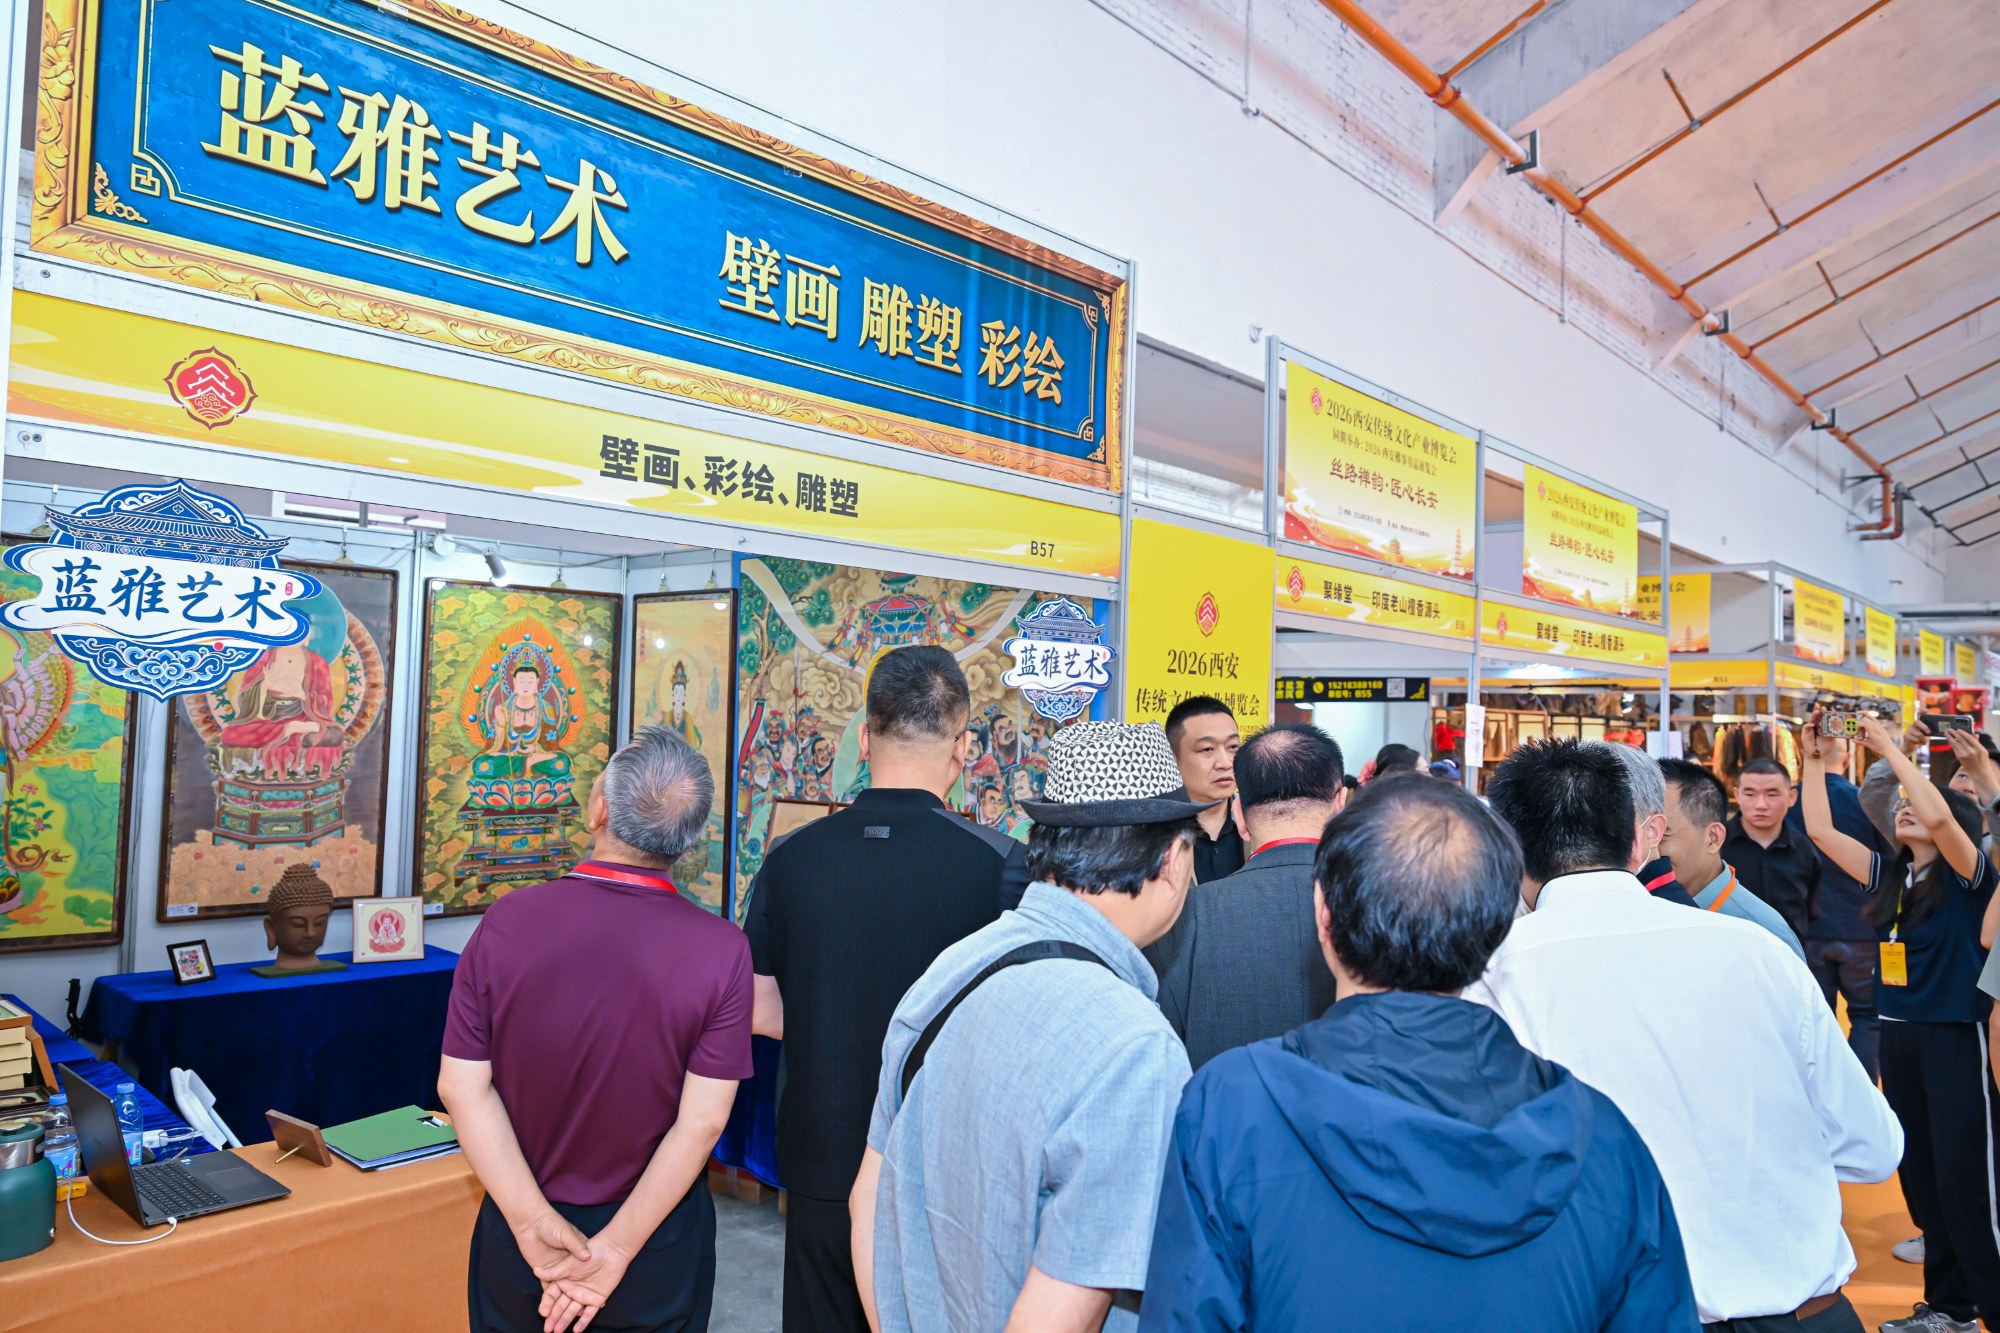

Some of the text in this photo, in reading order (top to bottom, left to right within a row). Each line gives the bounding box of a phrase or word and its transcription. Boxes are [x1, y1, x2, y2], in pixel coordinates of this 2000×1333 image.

[200, 41, 1066, 406] 蓝雅艺术 壁画 雕塑 彩绘
[1326, 398, 1457, 465] 2026西安传统文化产业博览会
[599, 434, 859, 518] 壁画、彩绘、雕塑
[1030, 540, 1055, 558] B57
[41, 556, 286, 629] 蓝雅艺术
[1017, 643, 1104, 680] 蓝雅艺术
[1167, 649, 1239, 679] 2026西安
